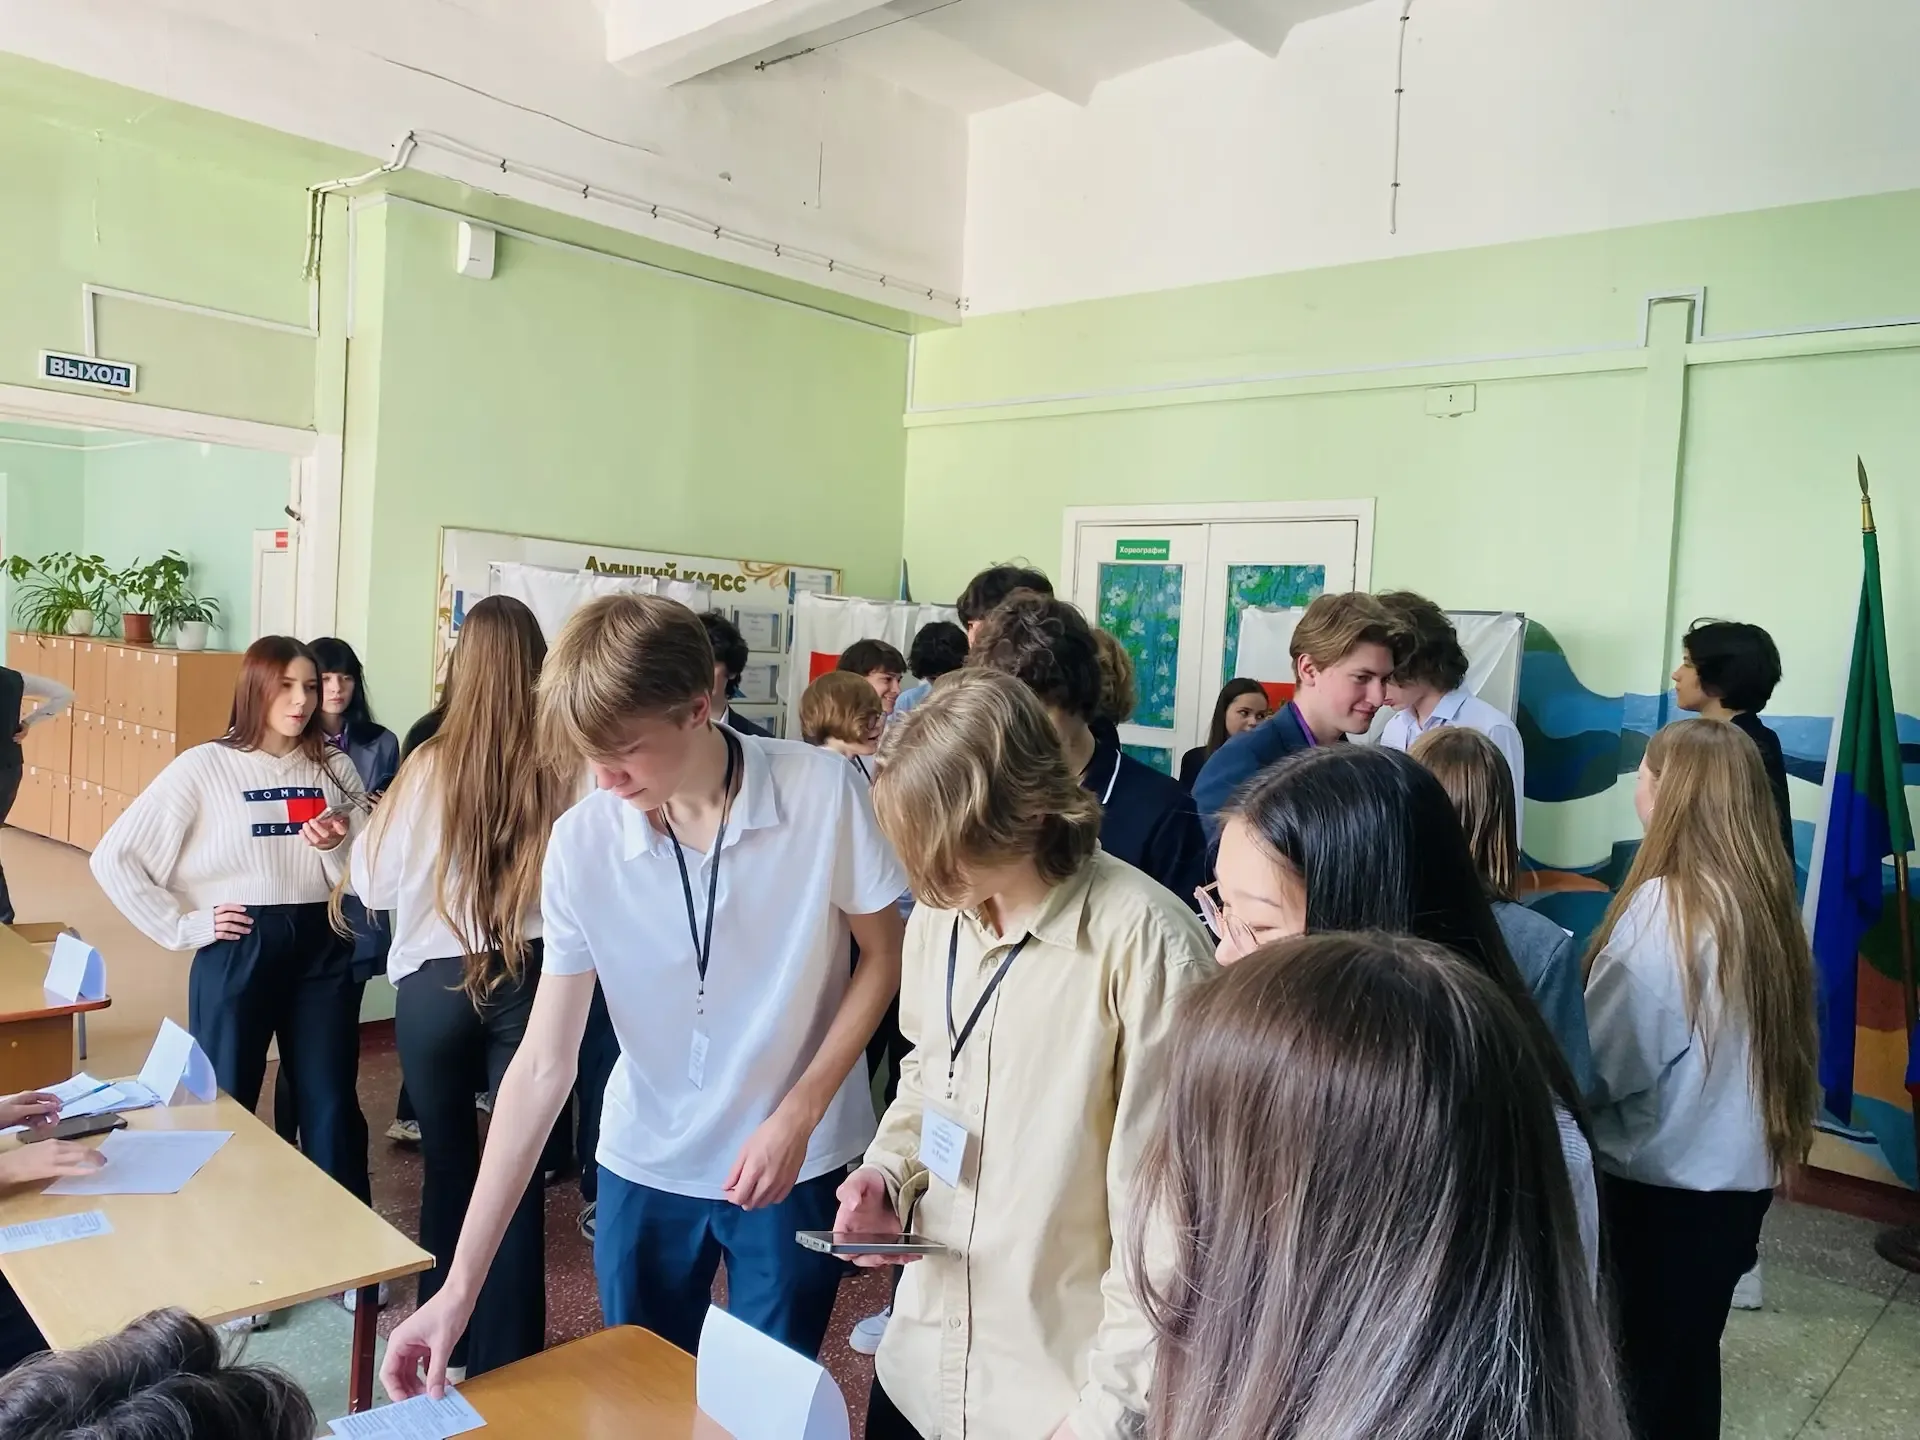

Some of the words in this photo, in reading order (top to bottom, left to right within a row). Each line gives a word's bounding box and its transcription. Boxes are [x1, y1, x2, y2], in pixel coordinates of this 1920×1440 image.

[49, 357, 127, 387] ВЫХОД
[1119, 546, 1167, 555] Хореография
[248, 788, 320, 800] TOMMY
[256, 825, 292, 834] JEA
